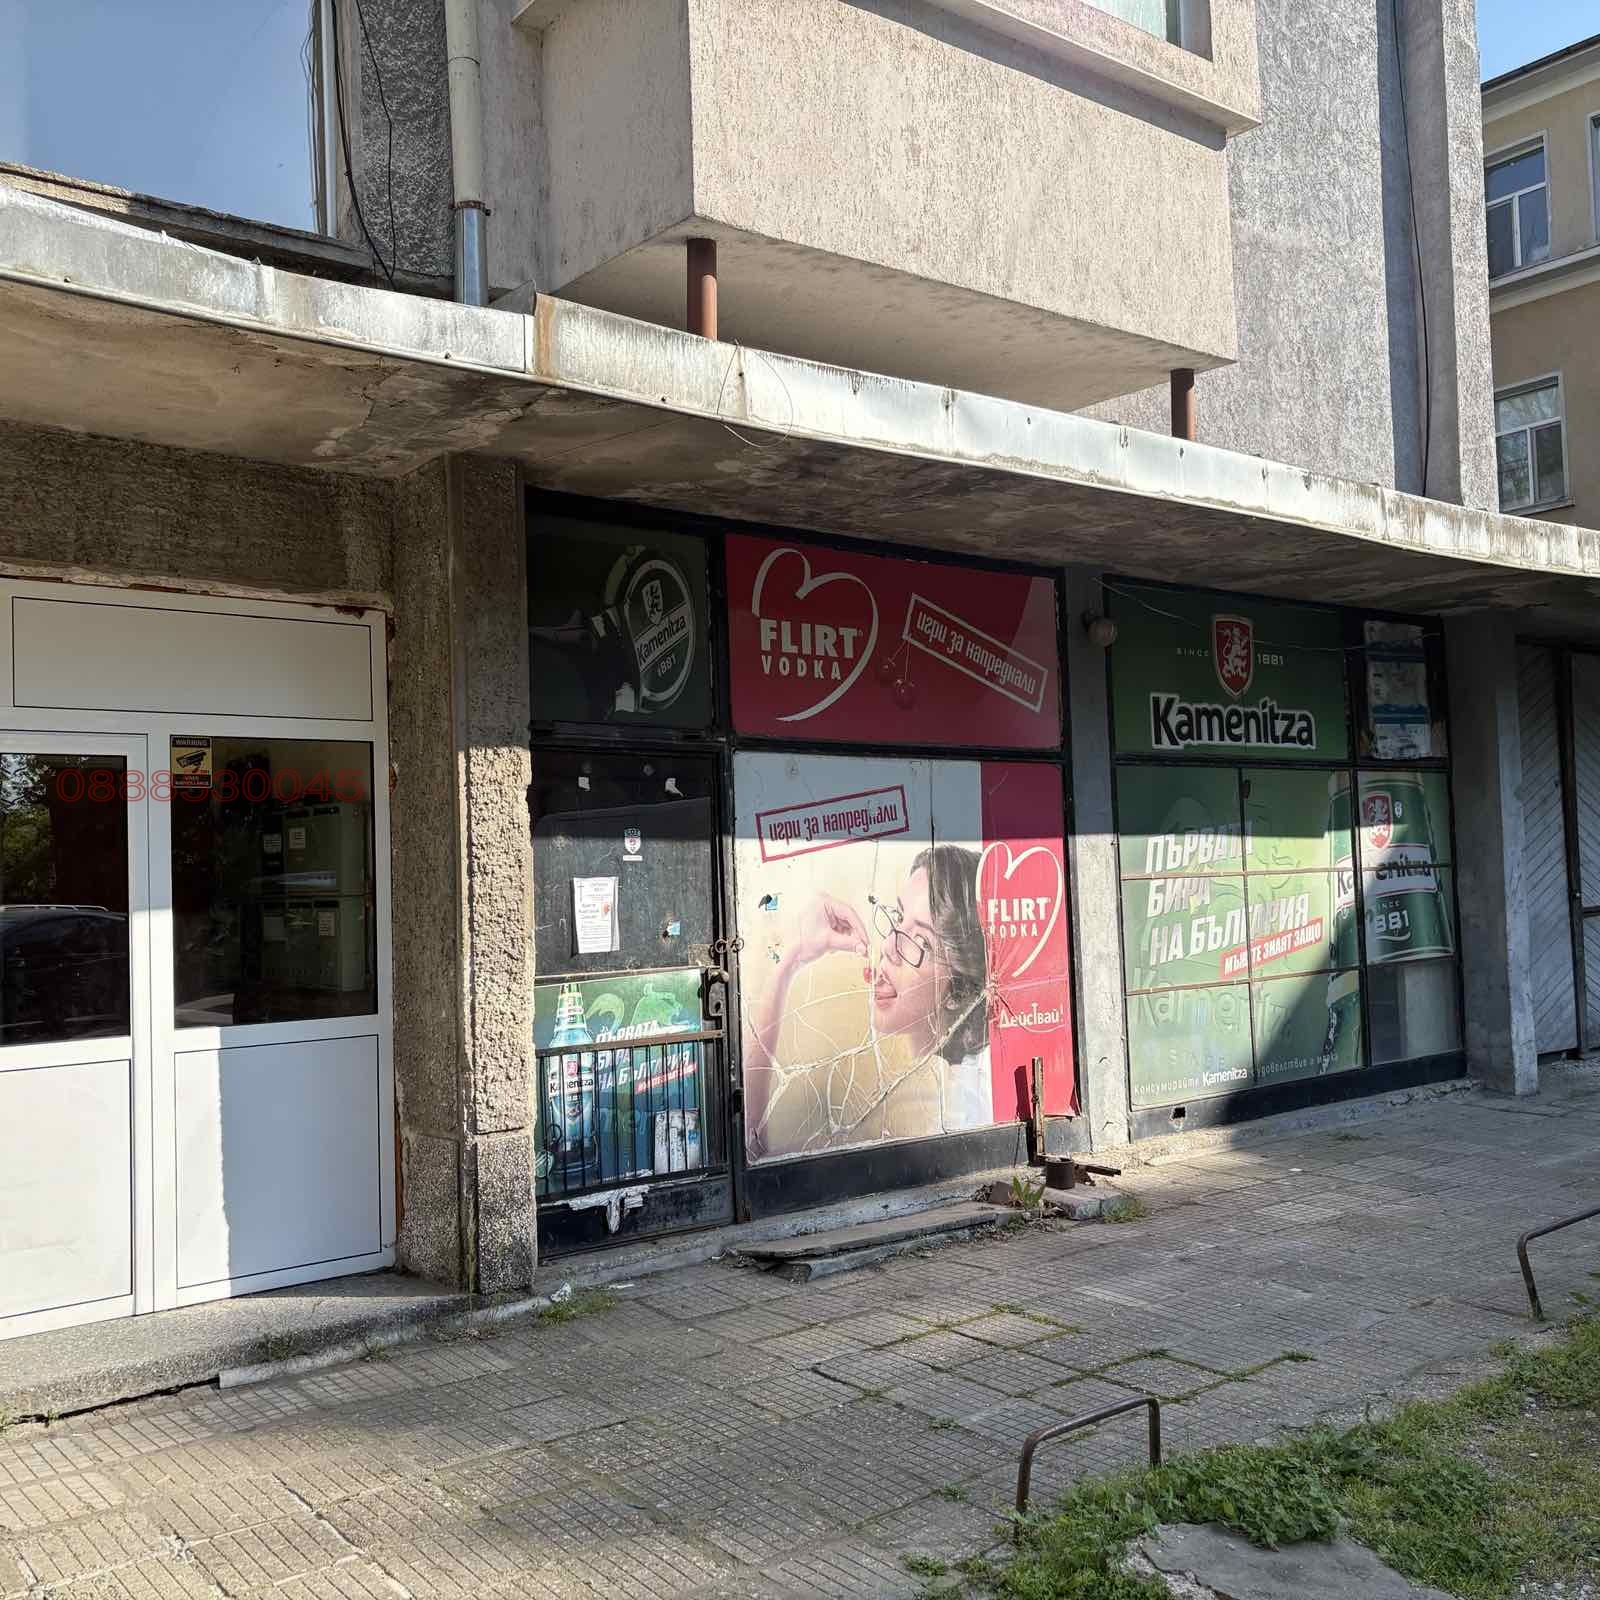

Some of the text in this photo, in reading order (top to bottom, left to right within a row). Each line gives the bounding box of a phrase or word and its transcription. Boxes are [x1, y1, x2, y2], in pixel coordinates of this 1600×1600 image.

[636, 615, 686, 664] Kamenitza
[760, 618, 858, 659] FLIRT
[916, 611, 1036, 694] игри за напреднали
[657, 654, 677, 678] 1881
[761, 655, 841, 680] VODKA
[1257, 653, 1284, 666] 1881
[1151, 694, 1315, 748] Kamenitza
[768, 819, 800, 846] игри
[804, 816, 820, 842] за
[1337, 853, 1432, 898] Kaenitza
[987, 897, 1049, 923] FLIRT
[1147, 878, 1211, 918] БИРА
[1151, 922, 1185, 966] НА
[1224, 922, 1322, 977] МЪЖТЕ ЗНАЯТ ЗАЩО
[1202, 1067, 1248, 1087] Kamenitza
